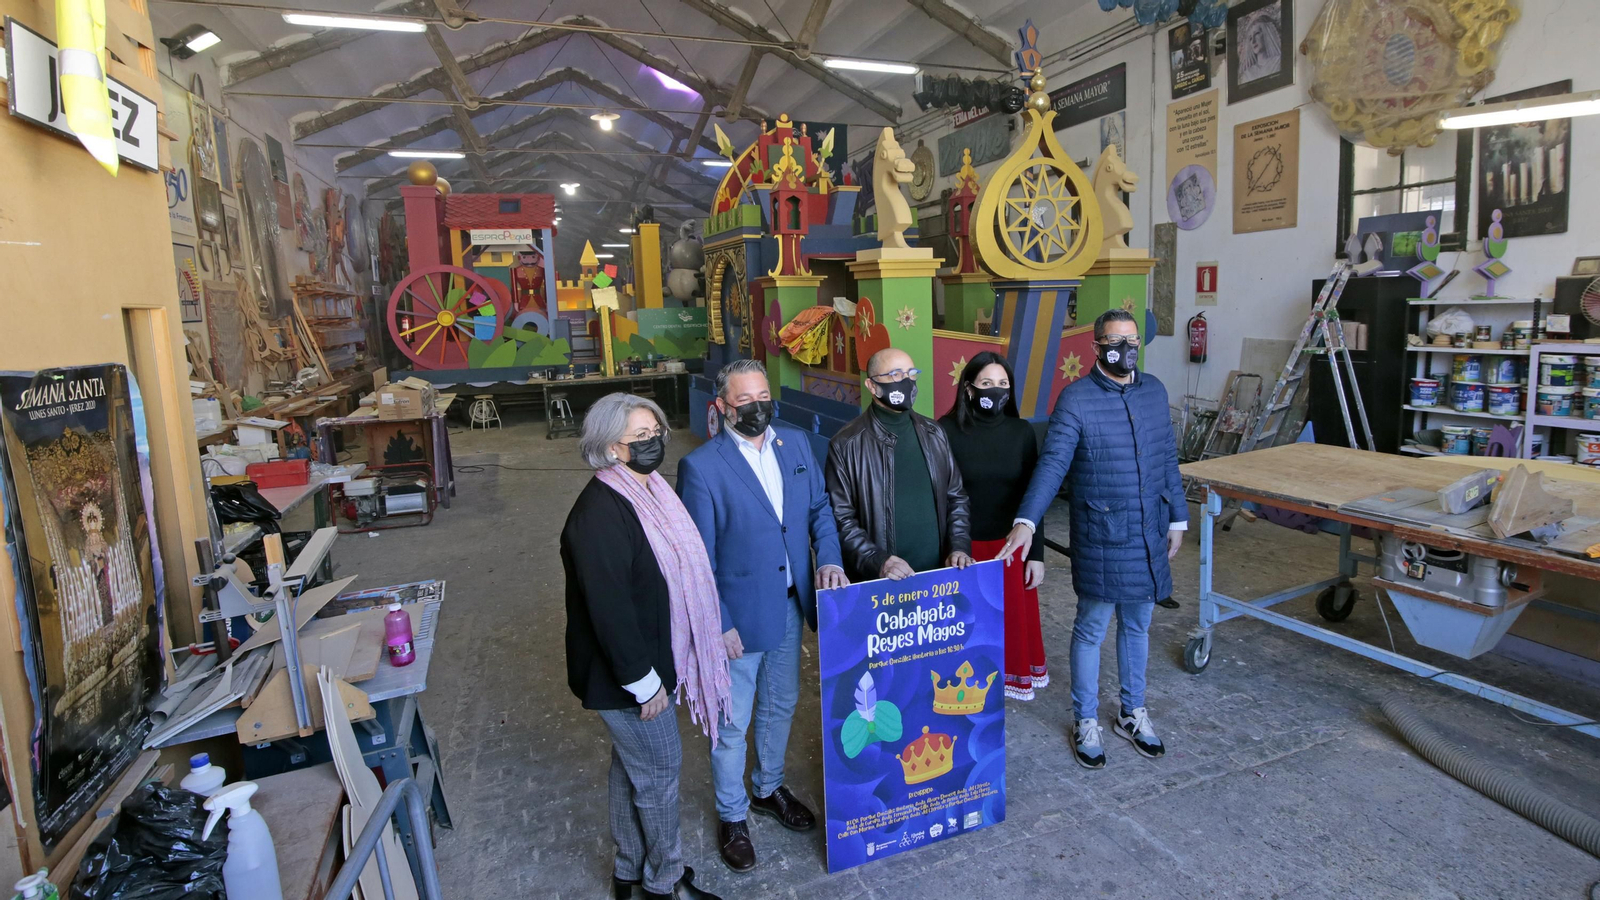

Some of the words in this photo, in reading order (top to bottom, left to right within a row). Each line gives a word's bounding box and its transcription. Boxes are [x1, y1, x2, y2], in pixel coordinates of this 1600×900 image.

[48, 55, 140, 148] JEZ
[1058, 92, 1084, 110] SEMANA
[1176, 114, 1192, 122] envuelta
[1254, 128, 1273, 136] SEMANA
[68, 378, 106, 401] SANTA
[28, 408, 47, 420] LUNES
[48, 405, 66, 418] SANTO
[69, 402, 85, 415] JEREZ
[85, 400, 96, 410] 2020
[871, 595, 878, 609] 5
[882, 593, 895, 606] de
[898, 589, 928, 604] enero
[932, 580, 960, 598] 2022
[876, 601, 956, 634] Cabalgata
[867, 632, 914, 658] Reyes
[918, 622, 966, 646] Magos
[868, 661, 888, 670] Parque
[889, 655, 912, 665] González
[912, 651, 934, 660] Hontoria
